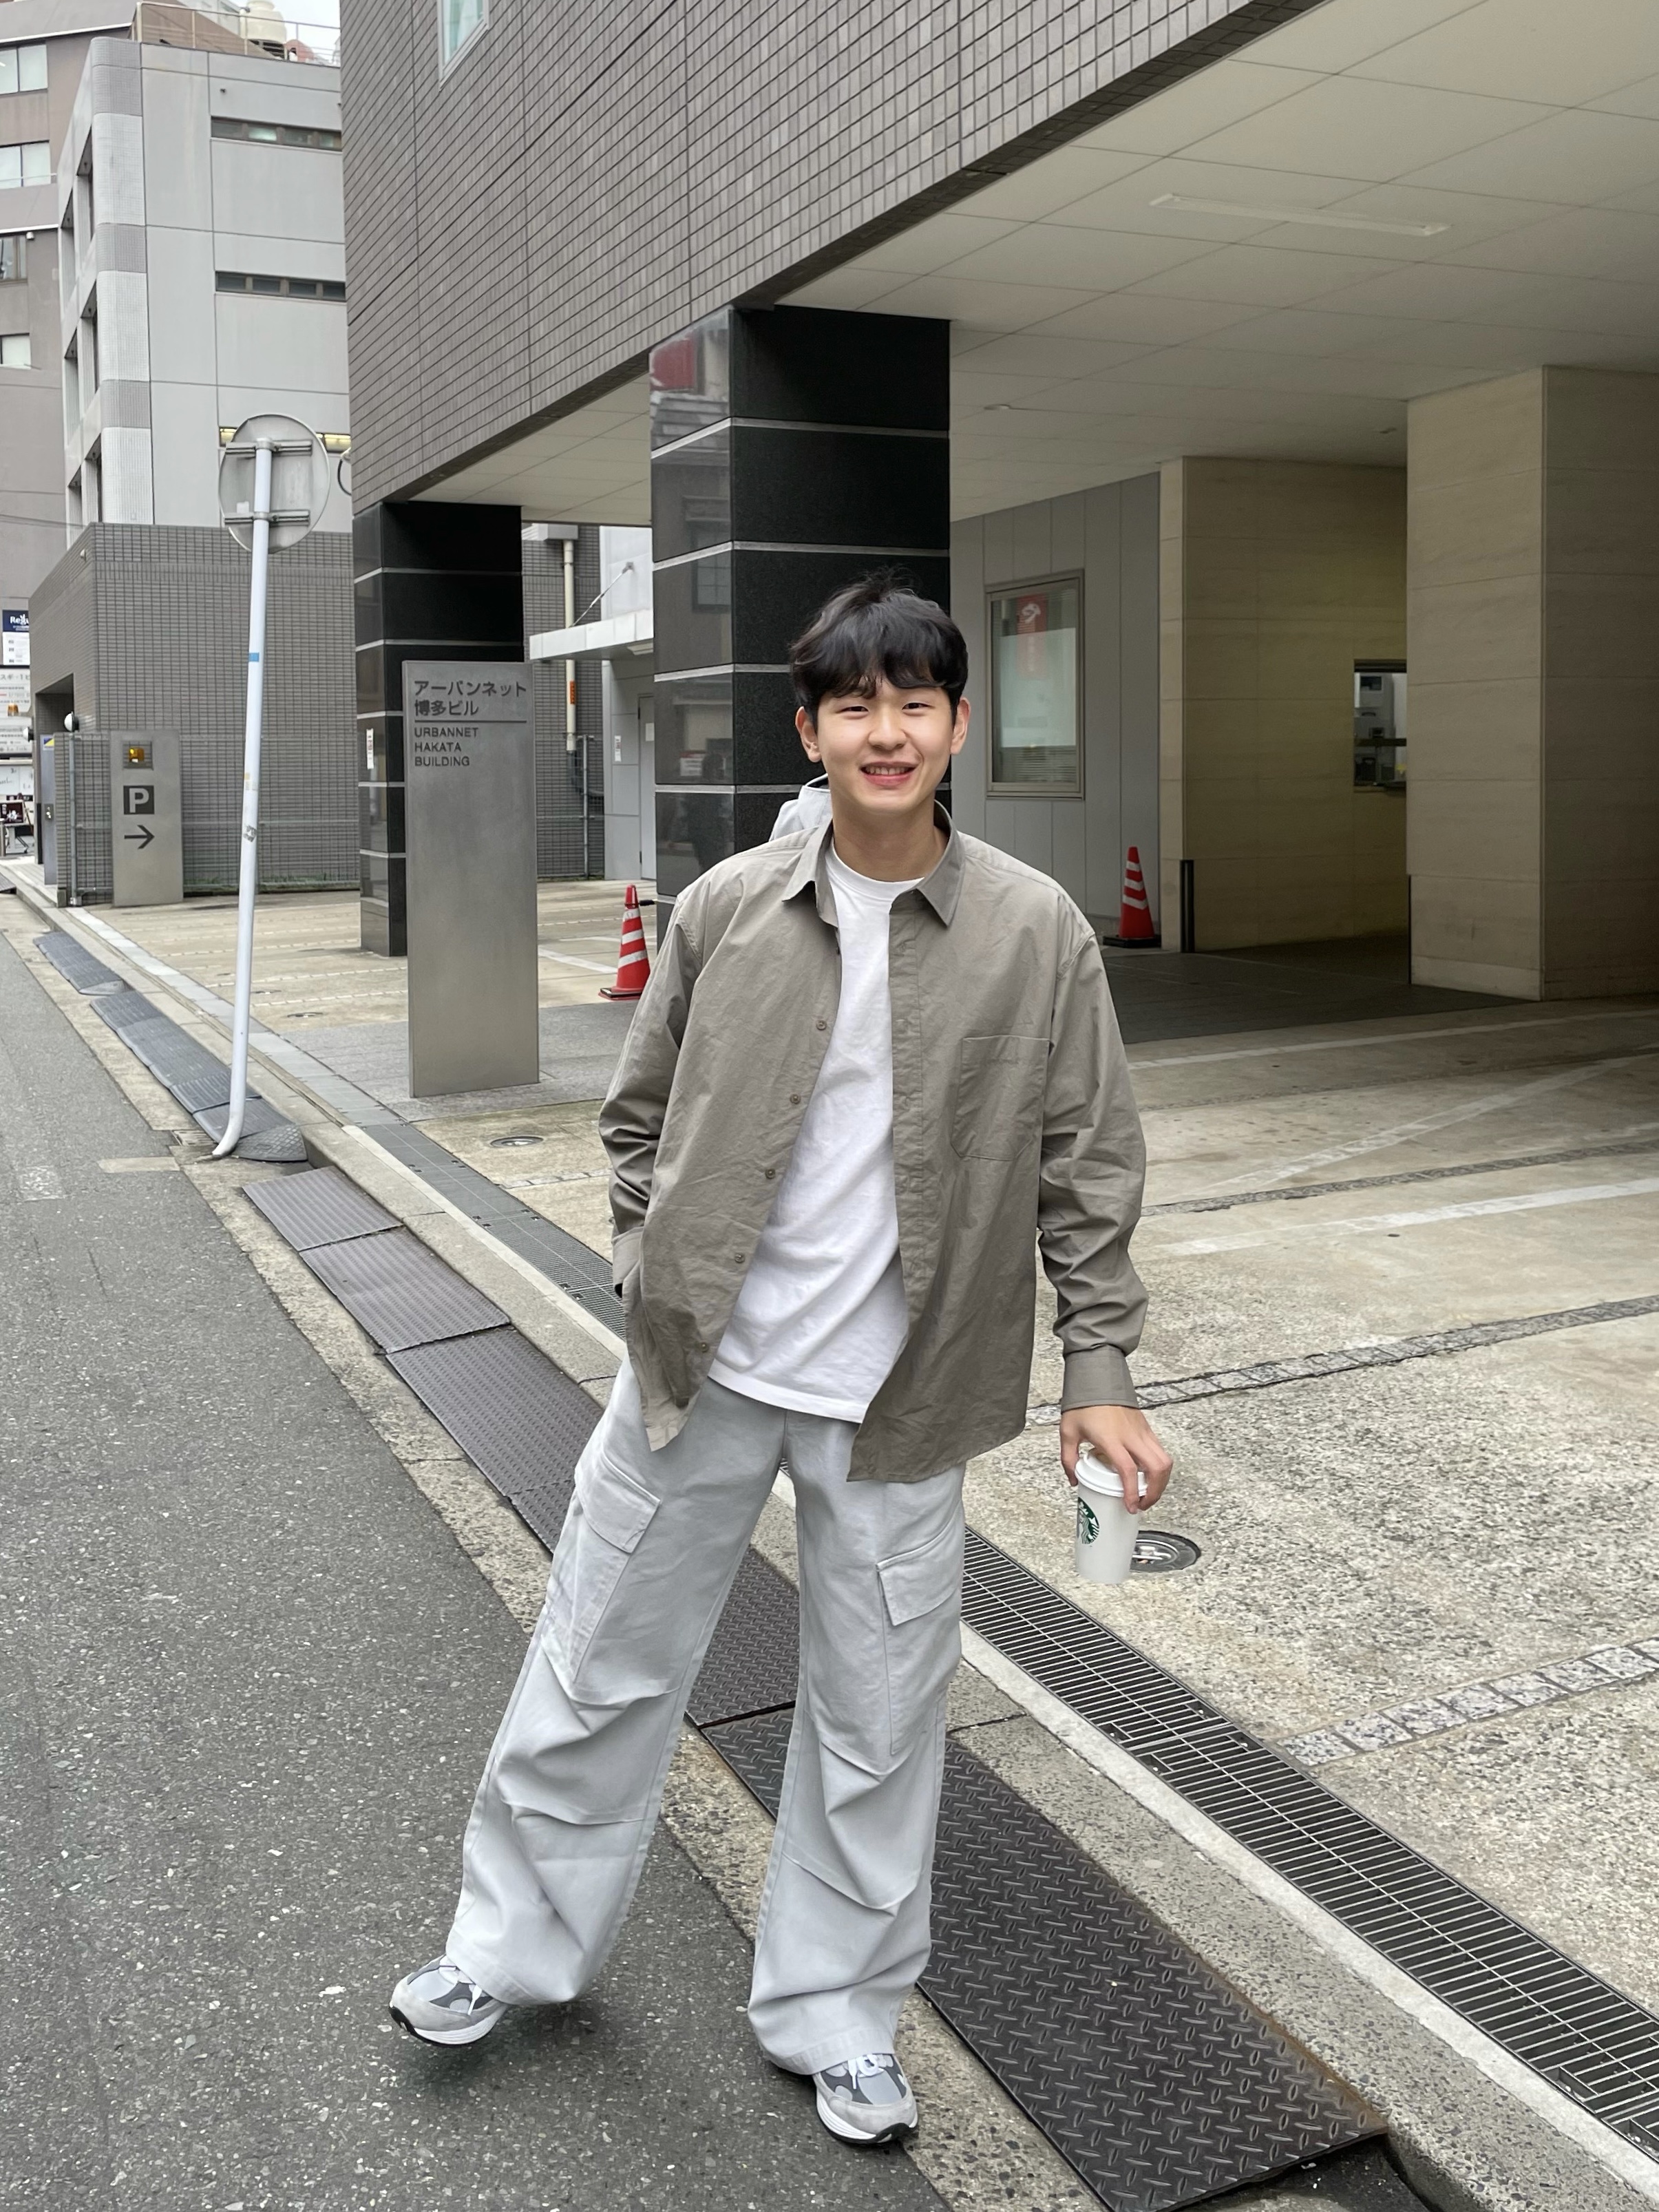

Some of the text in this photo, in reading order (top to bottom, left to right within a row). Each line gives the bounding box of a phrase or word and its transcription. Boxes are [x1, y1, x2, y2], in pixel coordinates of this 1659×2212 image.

[414, 680, 527, 697] アーバンネット
[414, 699, 479, 716] 博多ビル
[414, 727, 479, 738] URBANNET
[414, 741, 461, 752] HAKATA
[414, 756, 470, 767] BUILDING
[129, 788, 149, 813] P
